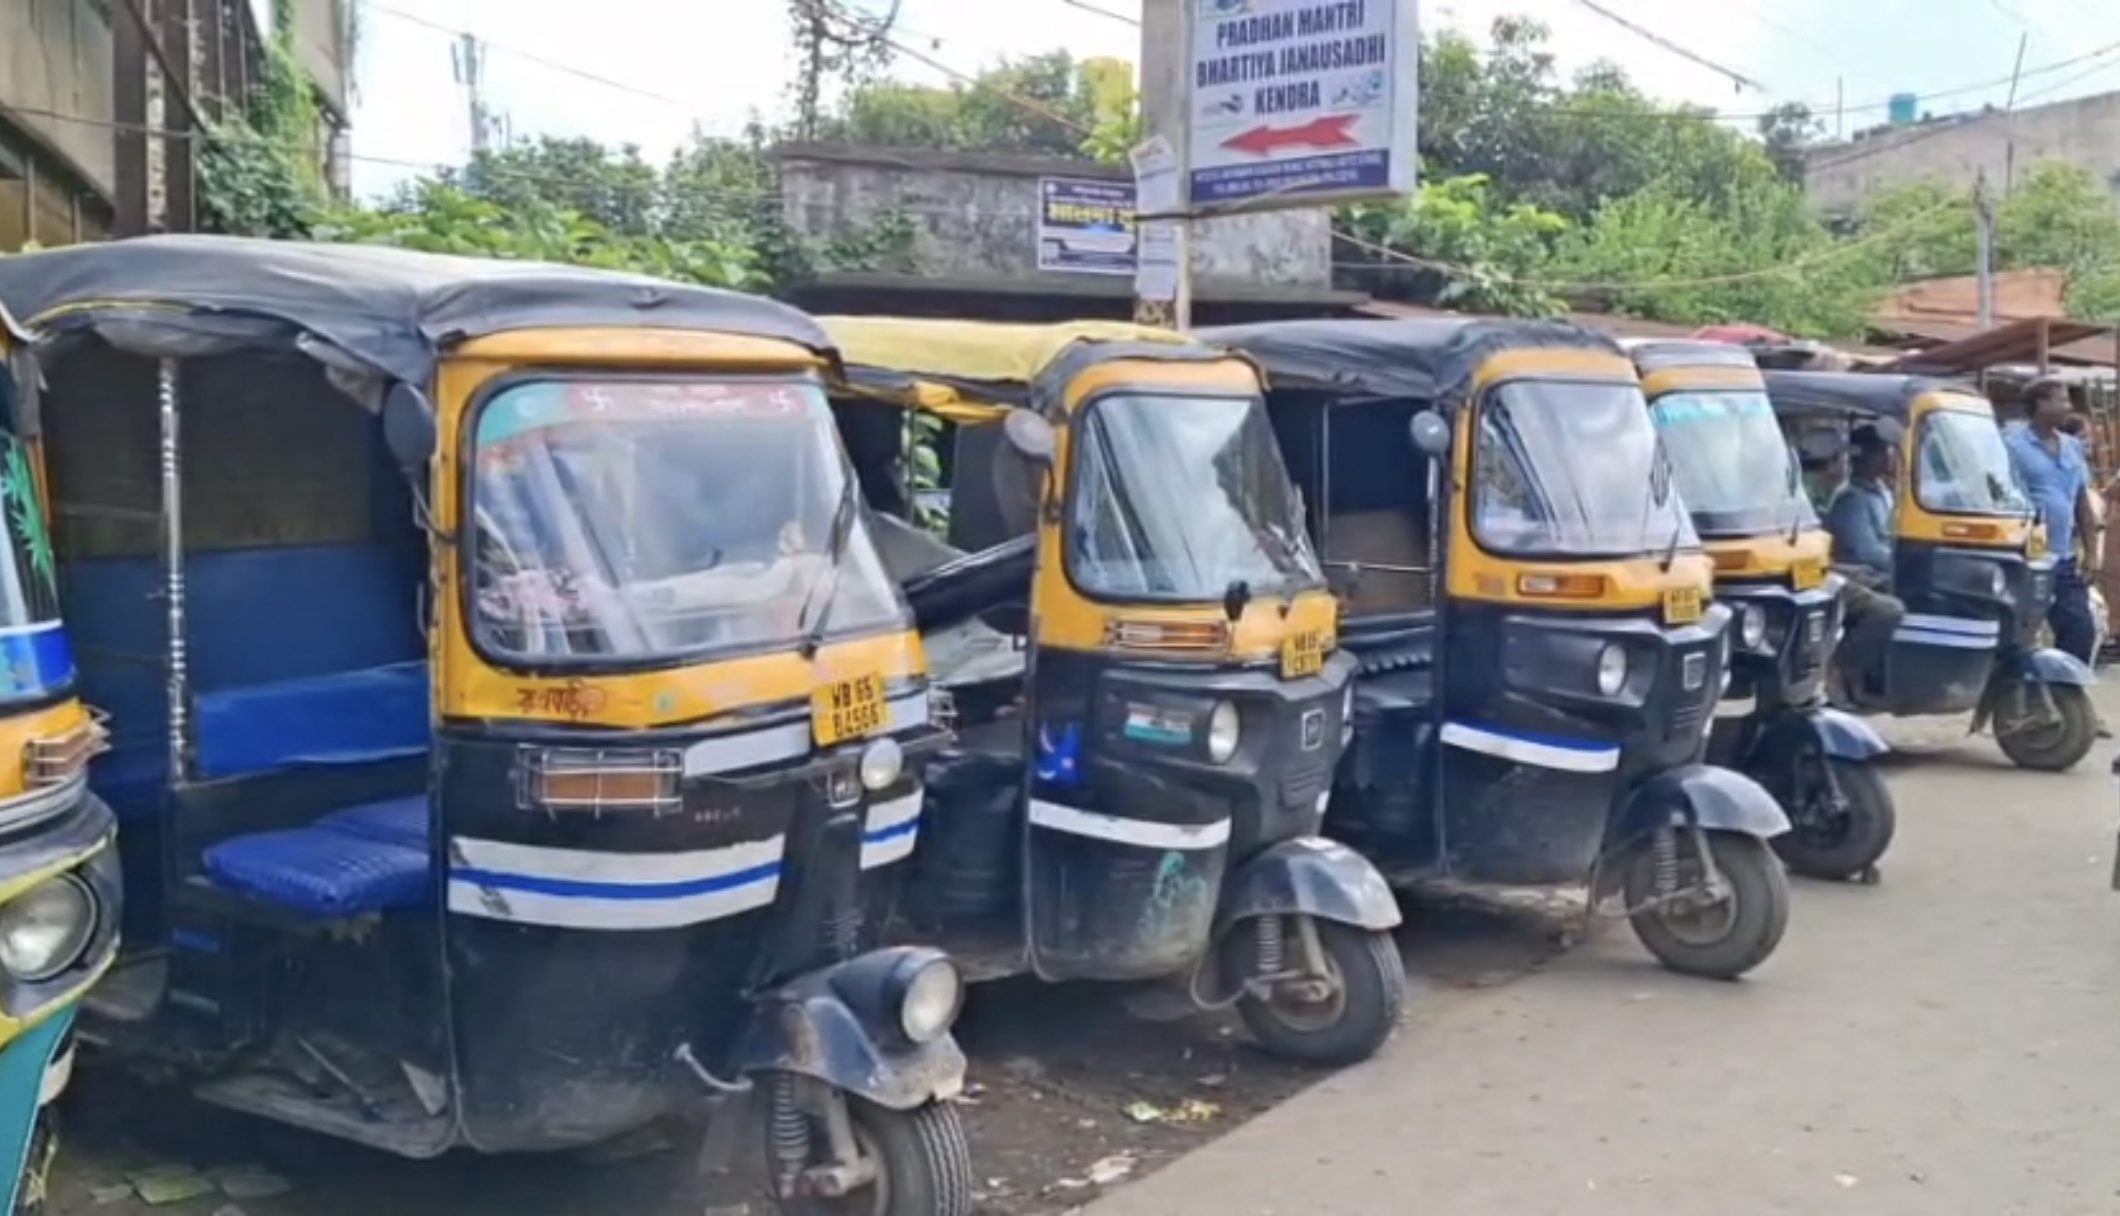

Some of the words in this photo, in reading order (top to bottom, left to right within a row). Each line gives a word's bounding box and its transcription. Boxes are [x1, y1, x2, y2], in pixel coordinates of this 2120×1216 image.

[1217, 10, 1293, 49] PRADHAN
[1297, 0, 1365, 37] MANTRI
[1196, 51, 1276, 89] BHARTIYA
[1280, 33, 1385, 75] JANAUSADHI
[1254, 80, 1320, 115] KENDRA
[832, 679, 852, 709] WB
